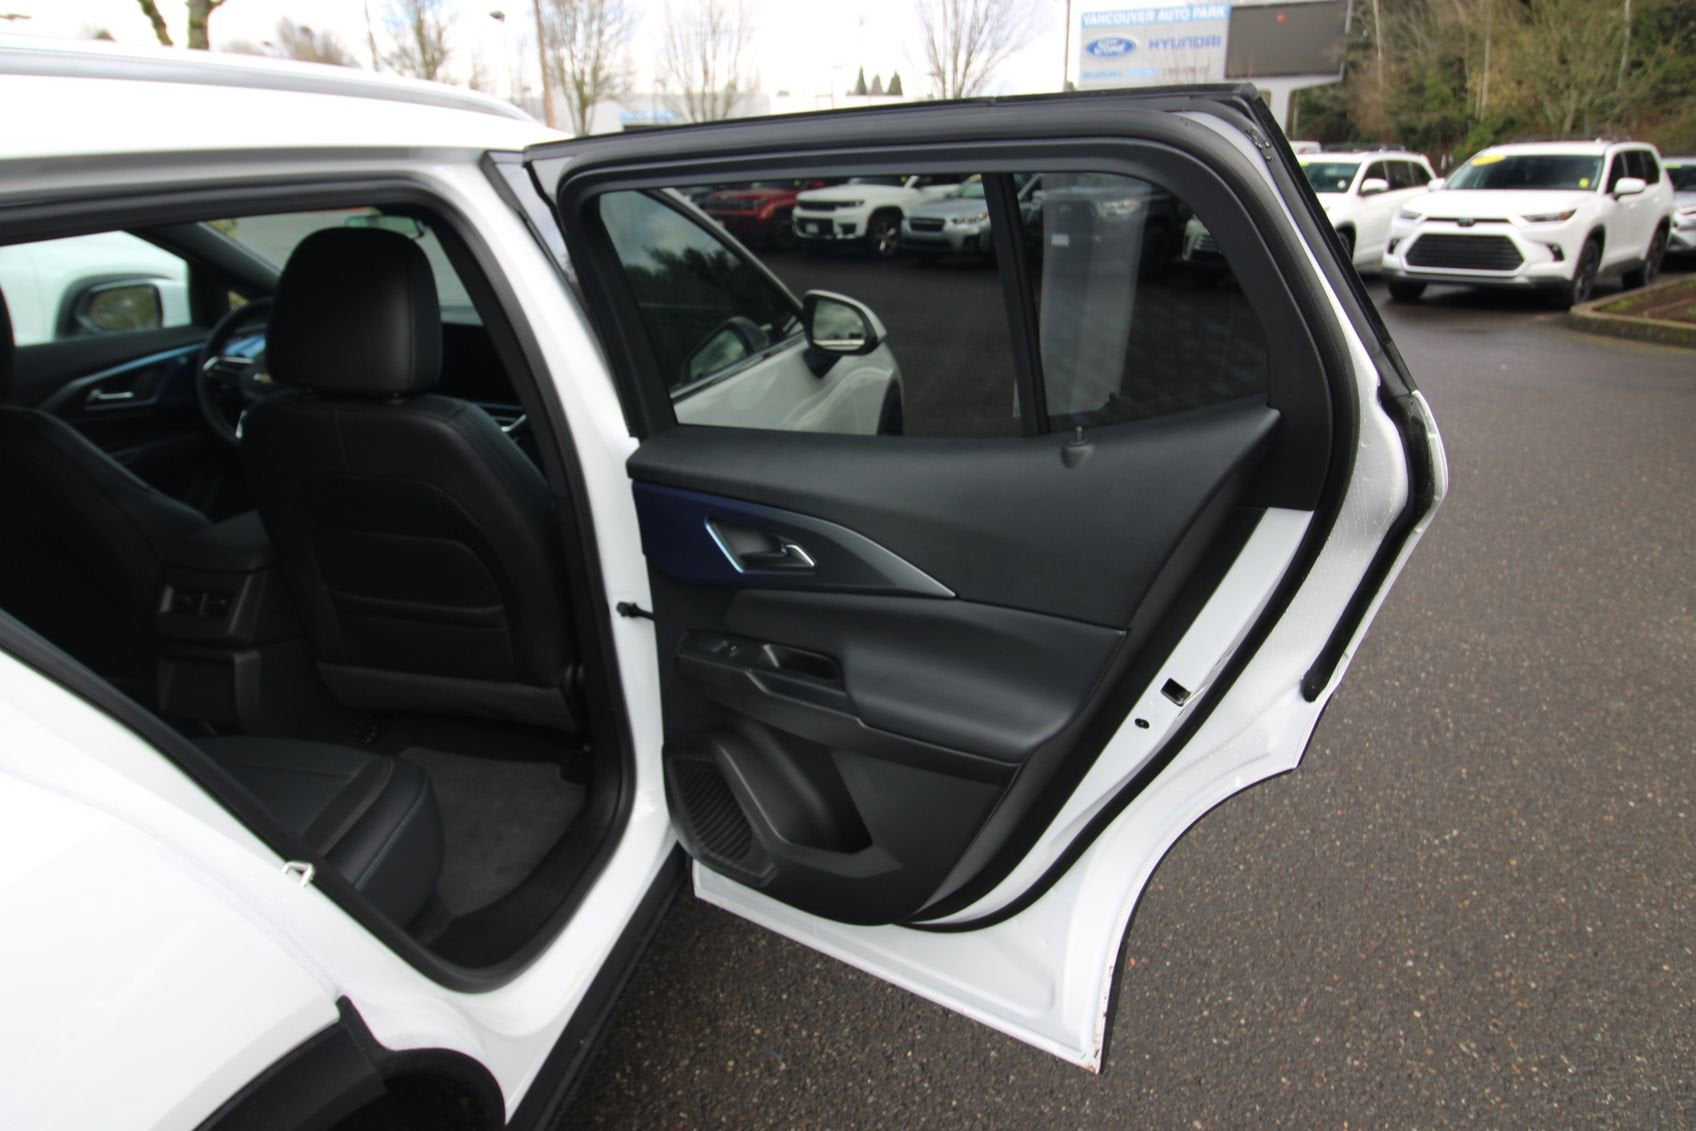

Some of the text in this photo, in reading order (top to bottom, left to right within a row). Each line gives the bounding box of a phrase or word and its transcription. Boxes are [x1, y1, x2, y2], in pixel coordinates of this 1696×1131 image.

[1082, 6, 1226, 26] VANCOUVER AUTO PARK
[1148, 35, 1221, 50] HYUNDAI
